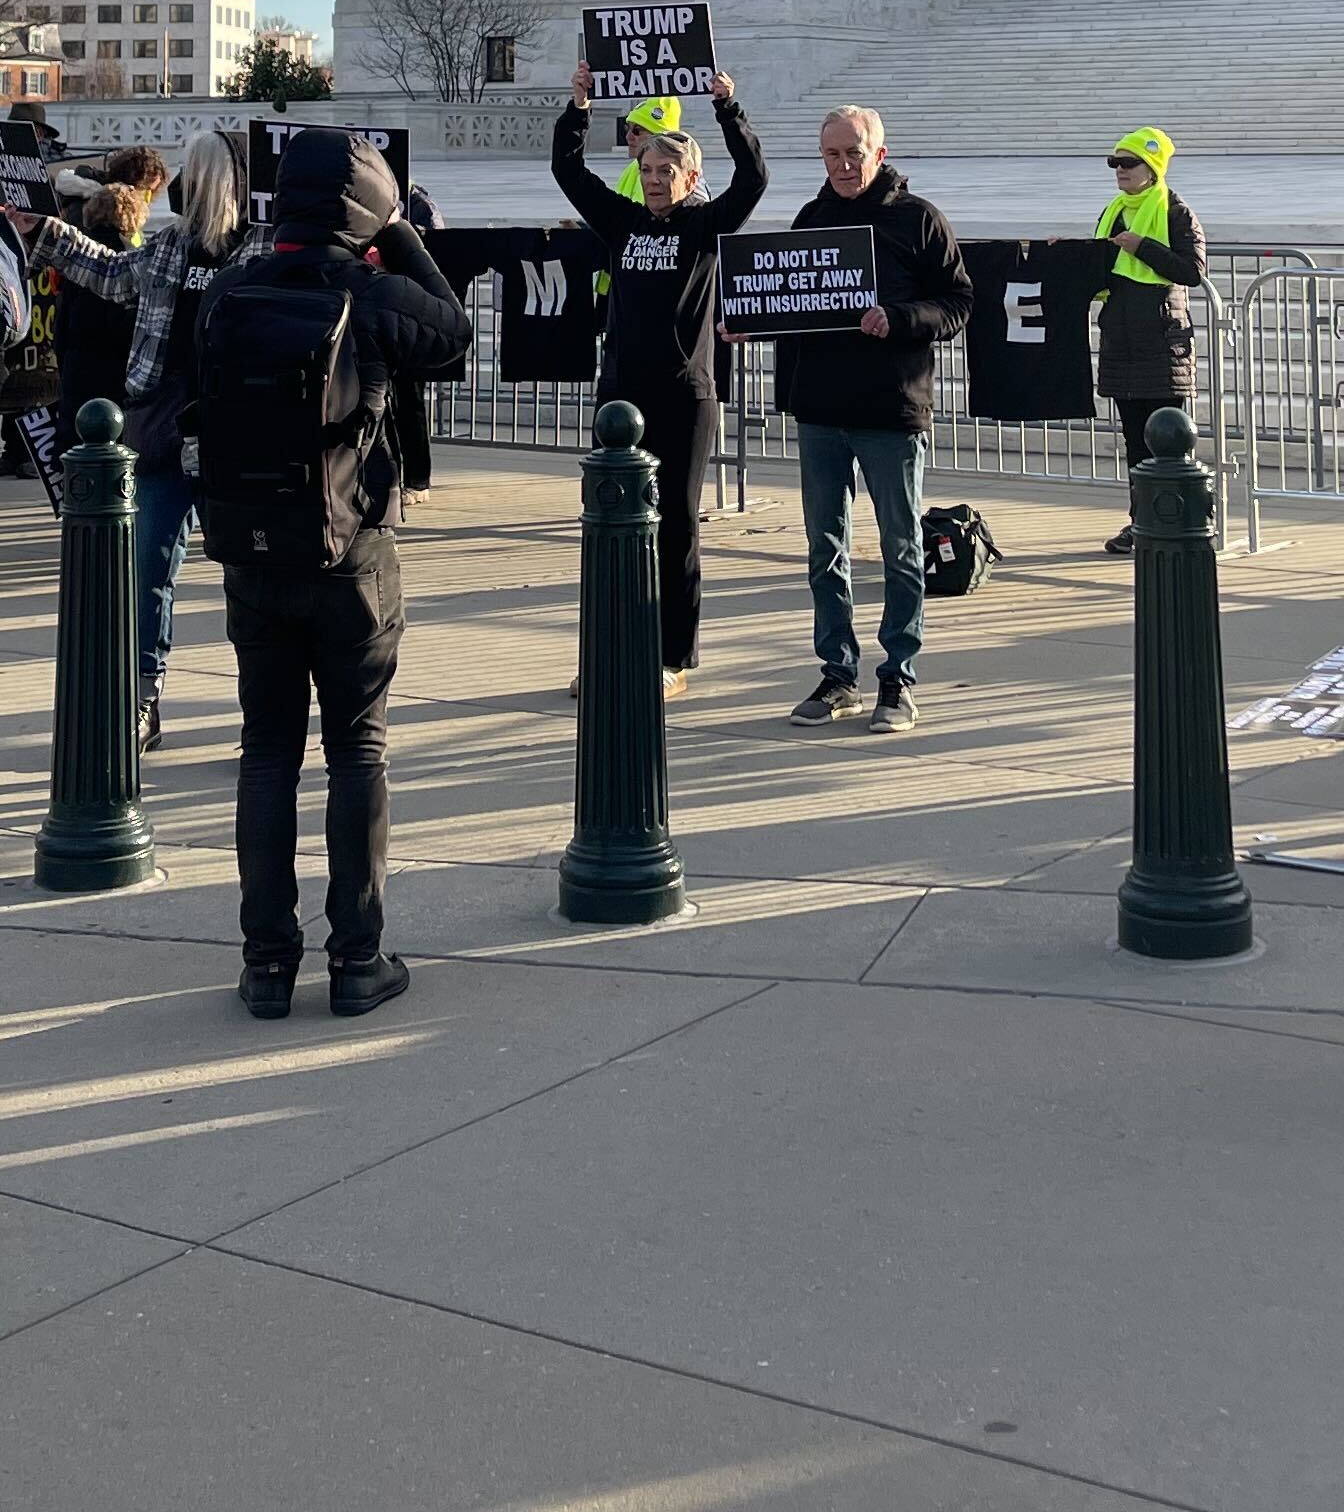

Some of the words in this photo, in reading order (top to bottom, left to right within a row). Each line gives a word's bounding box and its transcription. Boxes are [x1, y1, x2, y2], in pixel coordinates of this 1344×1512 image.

[595, 7, 694, 37] TRUMP
[620, 39, 648, 66] IS
[656, 38, 677, 65] A
[592, 66, 714, 97] TRAITOR
[0, 180, 33, 209] EGIN
[622, 244, 631, 257] A
[632, 245, 678, 258] DANGER
[628, 232, 665, 248] TRUMP
[667, 235, 680, 246] IS
[621, 256, 635, 270] TO
[637, 257, 653, 271] US
[654, 256, 678, 271] ALL
[754, 251, 775, 270] DO
[778, 249, 809, 269] NOT
[812, 247, 840, 266] LET
[733, 273, 784, 293] TRUMP
[788, 271, 818, 289] GET
[821, 268, 864, 288] AWAY
[723, 296, 762, 316] WITH
[766, 290, 876, 314] INSURRECTION
[1003, 281, 1046, 343] E
